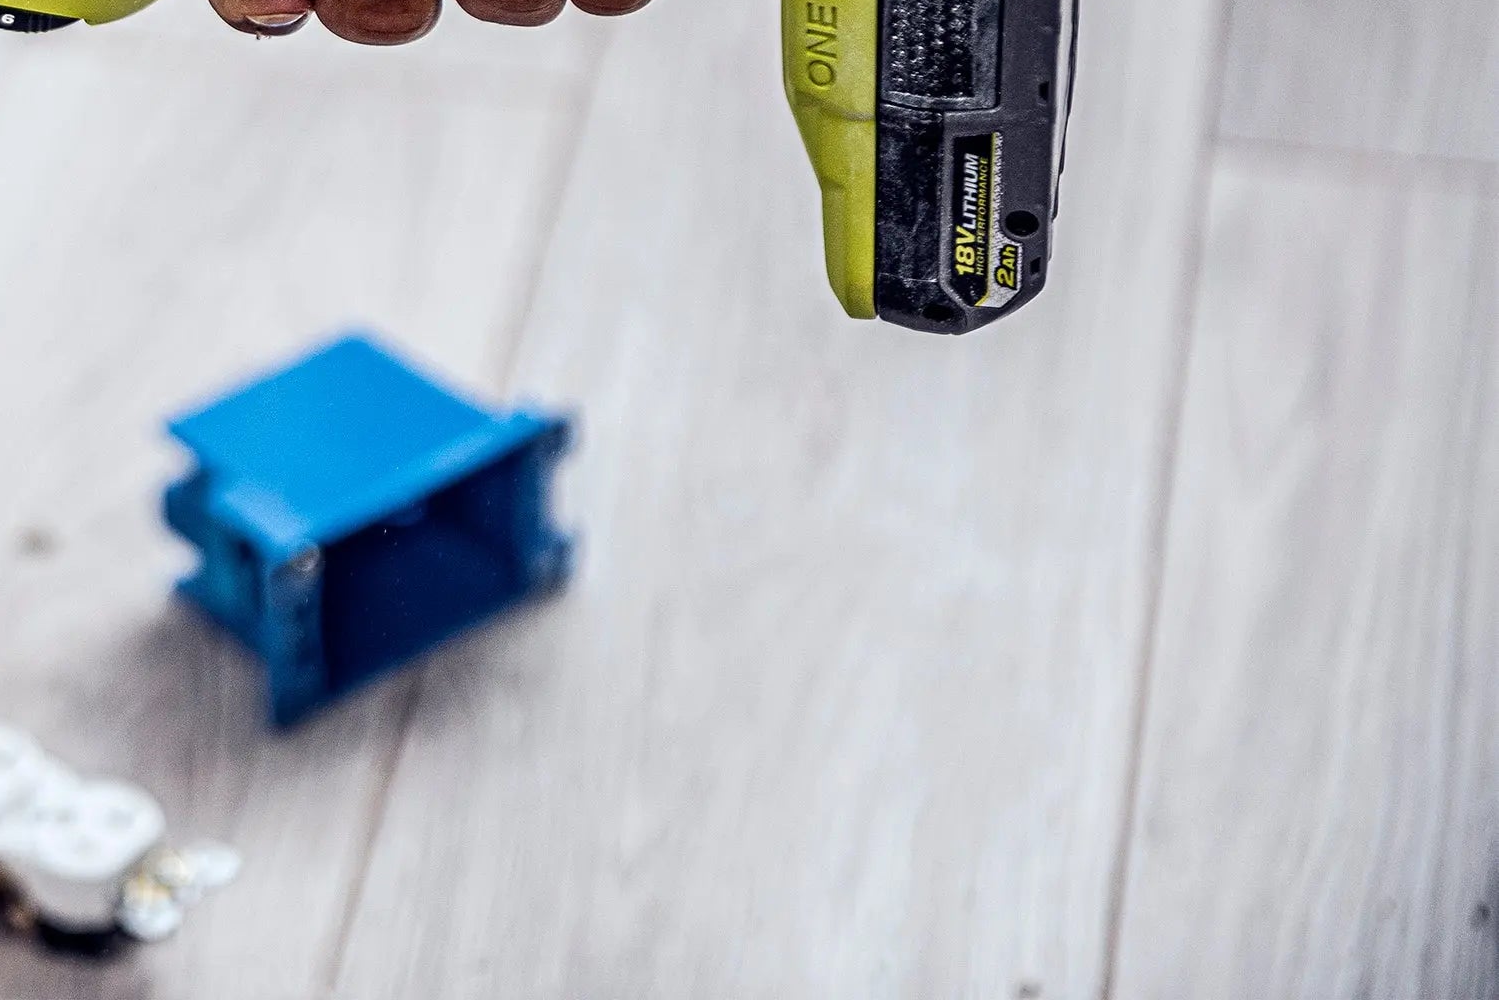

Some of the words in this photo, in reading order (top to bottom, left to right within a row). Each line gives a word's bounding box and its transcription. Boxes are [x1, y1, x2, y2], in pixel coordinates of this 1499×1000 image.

[0, 13, 15, 24] 6
[976, 156, 989, 244] PERFORMANCE
[976, 248, 986, 276] HIGH
